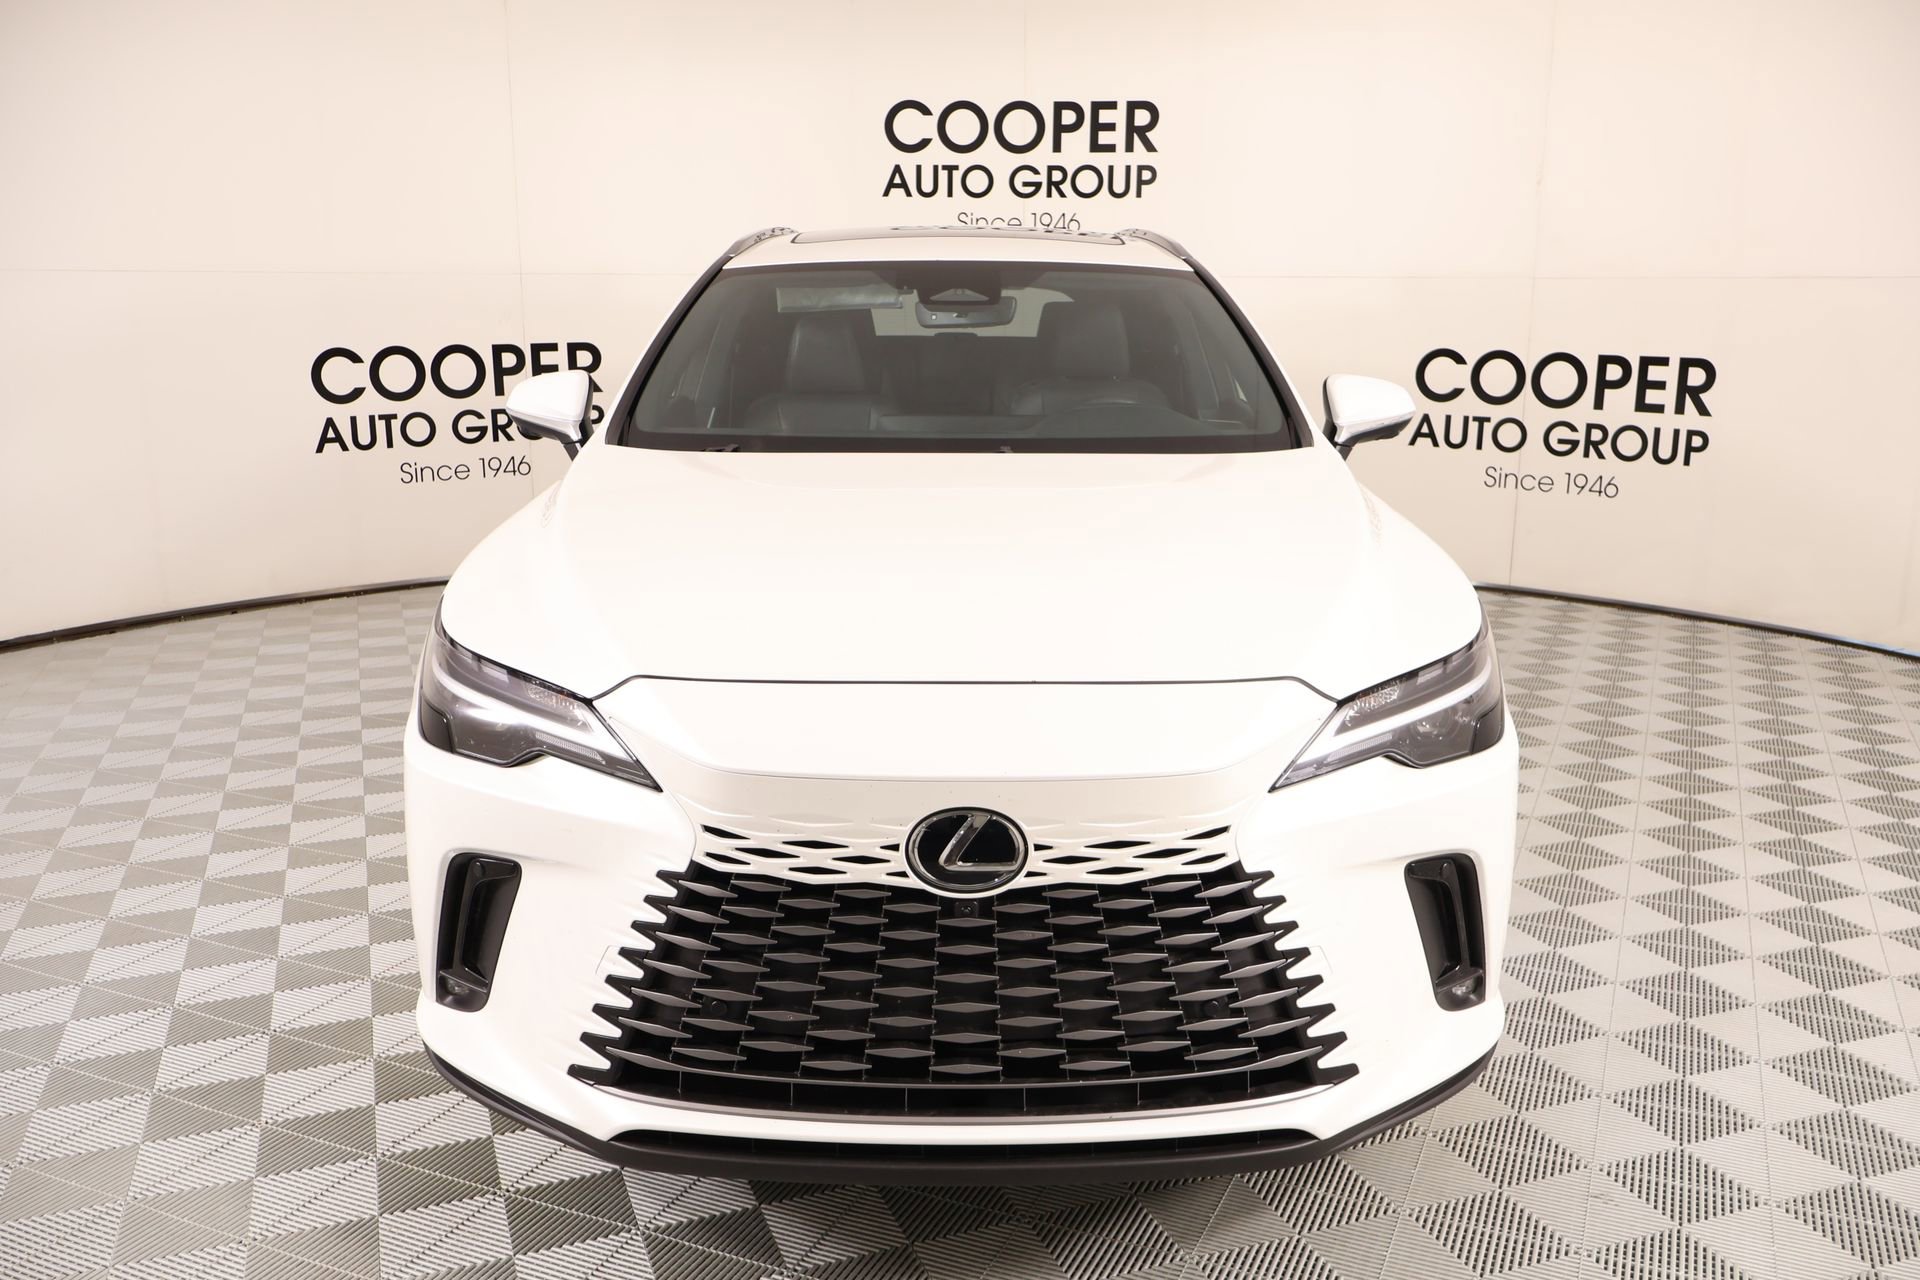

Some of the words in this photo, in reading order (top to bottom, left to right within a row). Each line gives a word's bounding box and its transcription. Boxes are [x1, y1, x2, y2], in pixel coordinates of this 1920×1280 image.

[884, 99, 1160, 154] COOPER
[882, 164, 995, 198] AUTO
[1008, 164, 1158, 199] GROUP
[1031, 211, 1081, 231] 1946
[310, 341, 604, 405] COOPER
[1415, 347, 1717, 417] COOPER
[315, 411, 437, 454] AUTO
[1407, 412, 1528, 453] AUTO
[1542, 420, 1710, 467] GROUP
[400, 461, 471, 484] Since
[478, 454, 532, 479] 1946
[1483, 465, 1555, 494] Since
[1564, 471, 1620, 499] 1946
